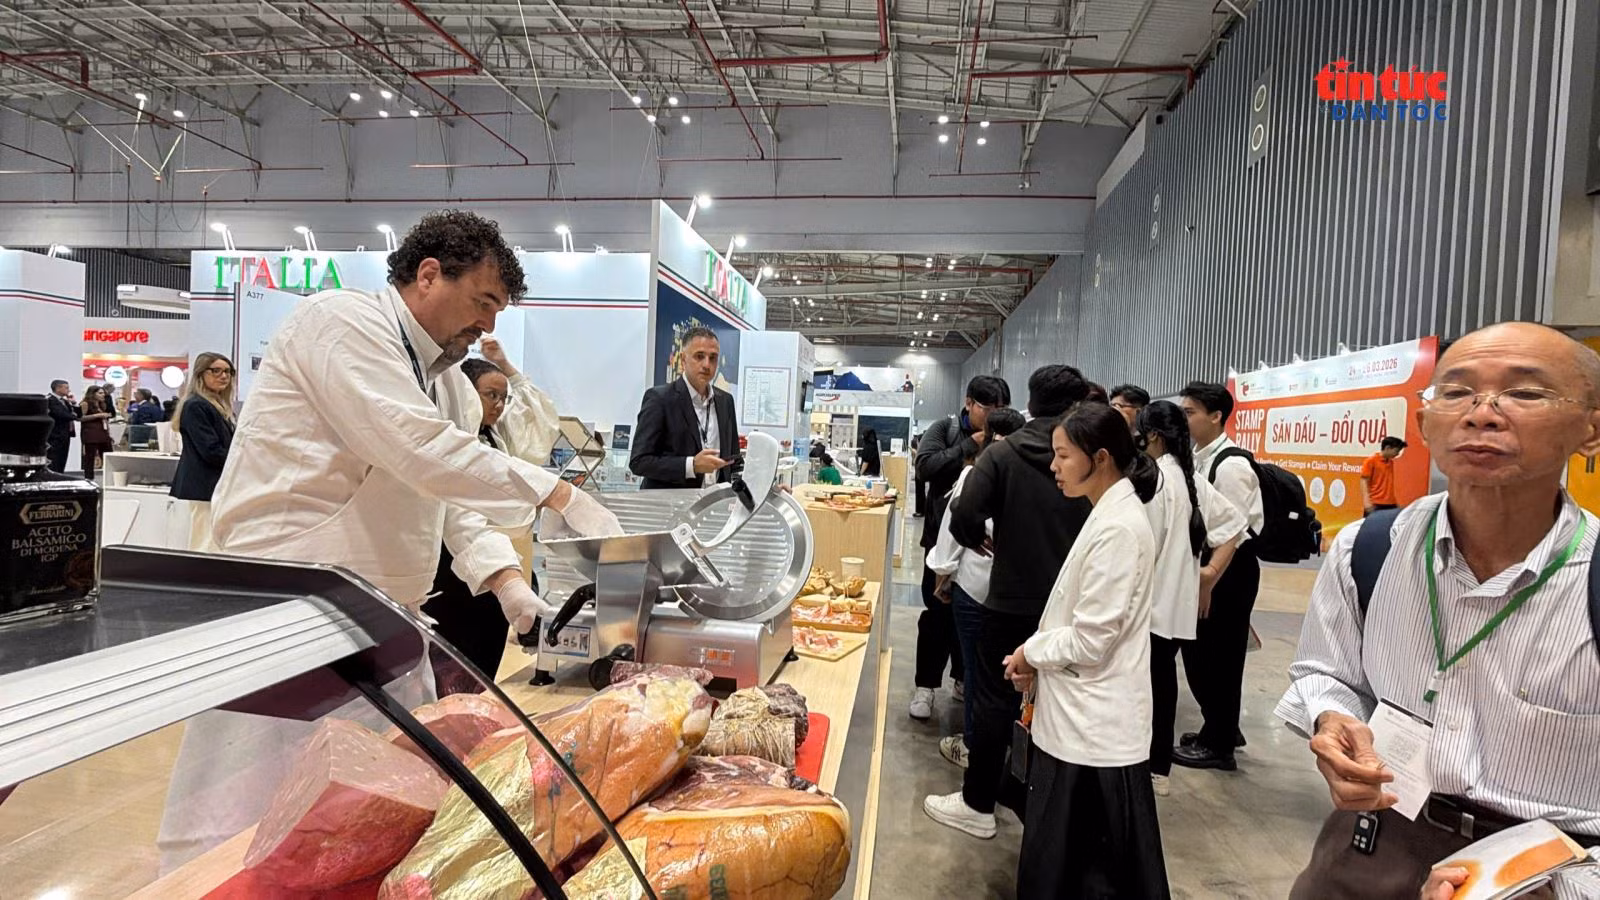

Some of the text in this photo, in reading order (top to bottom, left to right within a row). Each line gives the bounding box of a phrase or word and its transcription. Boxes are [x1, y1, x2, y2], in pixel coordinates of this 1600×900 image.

[215, 255, 343, 289] ITALIA
[246, 290, 264, 301] A377
[1235, 408, 1265, 430] STAMP
[1272, 416, 1291, 444] SĂN
[1293, 414, 1317, 444] DẤU
[1331, 410, 1354, 444] ĐỔI
[1358, 410, 1388, 448] QUÀ
[1235, 432, 1262, 454] RALLY
[1311, 460, 1327, 471] Claim
[1328, 461, 1342, 471] Your
[1342, 462, 1362, 473] Rewar
[29, 508, 74, 519] FERRARINI
[28, 525, 73, 537] ACETO
[12, 533, 87, 549] BALSAMICO
[20, 544, 78, 557] DI MODENA
[41, 553, 58, 562] IGP
